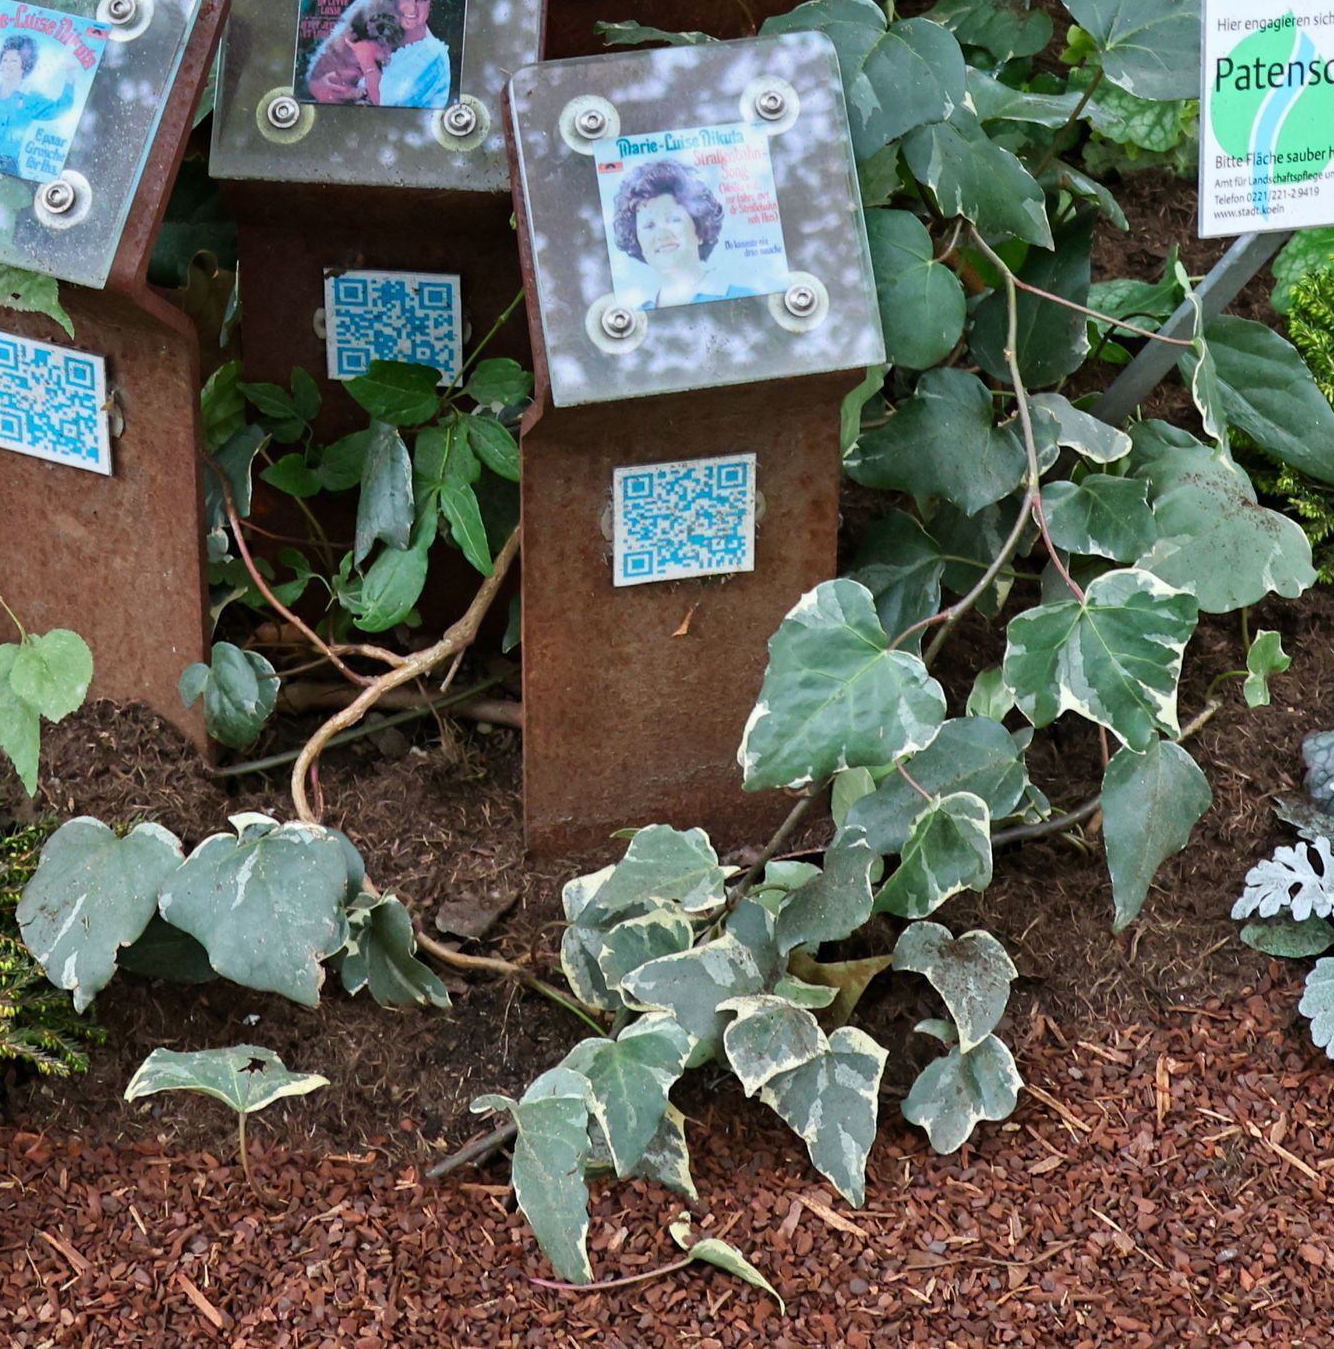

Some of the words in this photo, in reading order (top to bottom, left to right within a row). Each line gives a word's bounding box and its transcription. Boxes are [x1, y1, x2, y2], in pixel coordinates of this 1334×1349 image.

[1217, 17, 1242, 32] Hier
[1244, 14, 1311, 33] engagieren
[616, 132, 699, 160] Marie-Luise
[1215, 154, 1243, 170] Bitte
[1246, 151, 1284, 167] Fläche
[1286, 147, 1326, 163] sauber
[1214, 177, 1233, 188] Amt
[1234, 174, 1247, 188] für
[1248, 169, 1324, 187] Landschaftspflege
[1214, 193, 1245, 205] Telefon
[1213, 203, 1285, 219] www.stadt.koeln
